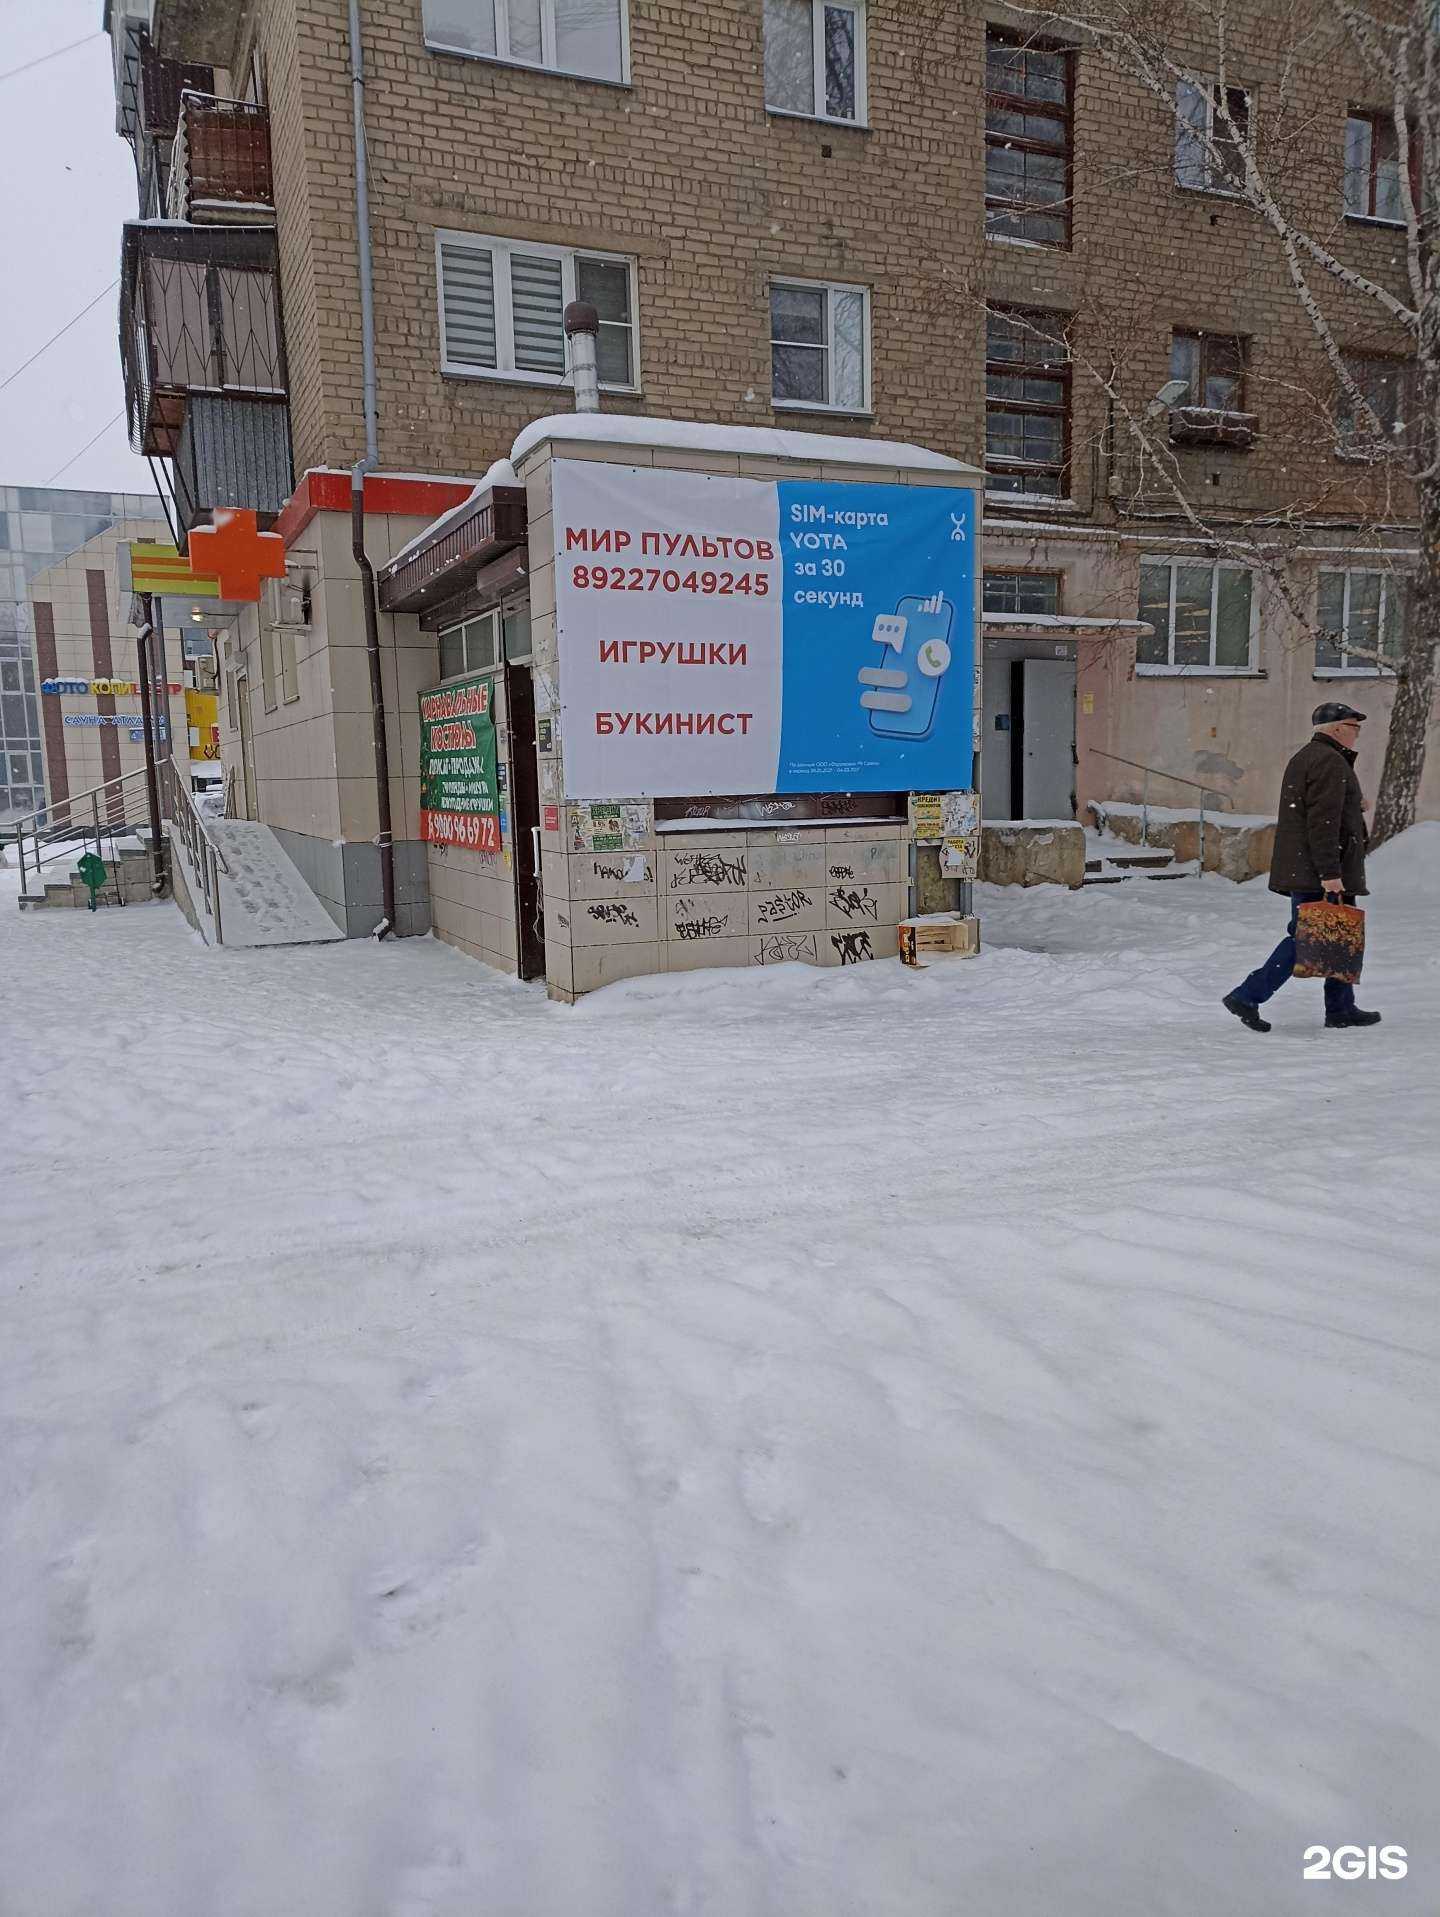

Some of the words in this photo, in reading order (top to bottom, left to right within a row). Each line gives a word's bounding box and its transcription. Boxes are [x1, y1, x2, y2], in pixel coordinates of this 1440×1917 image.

[790, 503, 889, 530] SIM-карта
[565, 527, 632, 553] МИР
[641, 531, 774, 560] ПУЛЬТОВ
[790, 532, 848, 550] YOTA
[794, 562, 817, 576] за
[821, 558, 845, 577] 30
[572, 564, 769, 596] 89227049245
[793, 590, 865, 609] секунд
[599, 640, 747, 666] ИГРУШКИ
[595, 712, 753, 735] БУКИНИСТ
